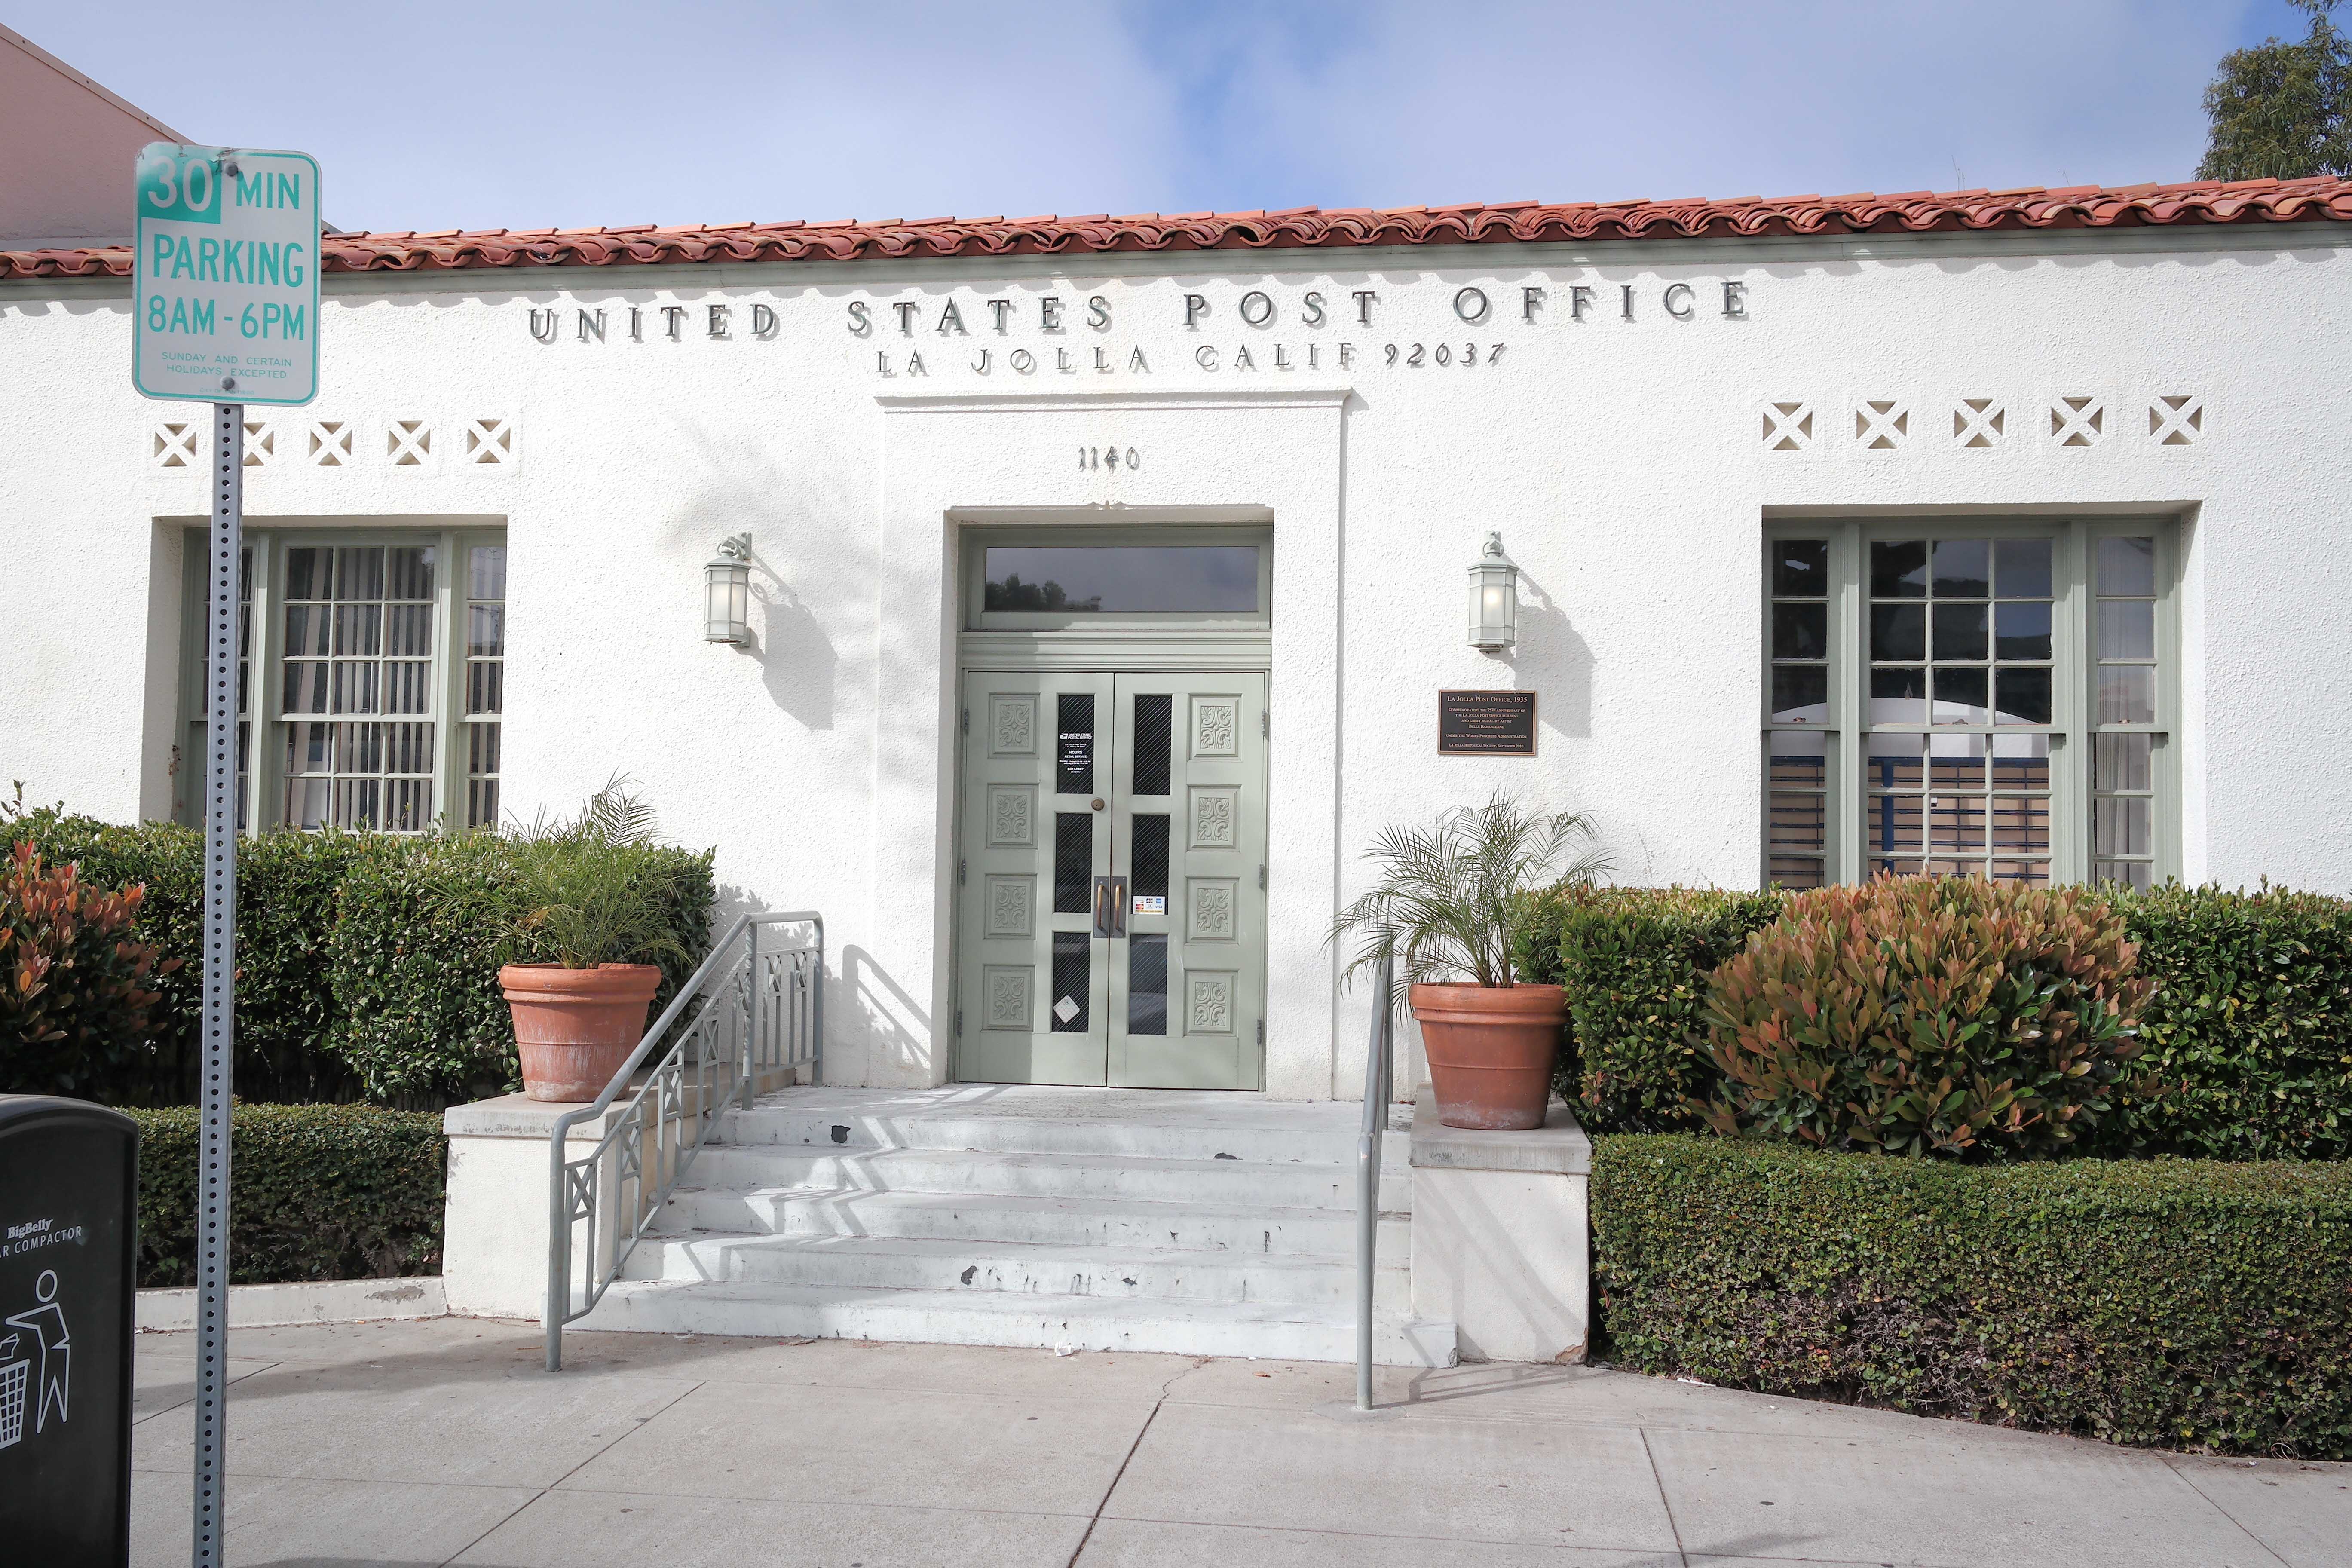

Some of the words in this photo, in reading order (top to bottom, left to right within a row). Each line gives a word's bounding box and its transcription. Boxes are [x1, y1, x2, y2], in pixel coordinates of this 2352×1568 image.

[148, 155, 213, 212] 30
[236, 171, 299, 210] MIN
[152, 233, 303, 288] PARKING
[527, 304, 774, 339] UNITED
[847, 296, 1107, 332] STATES
[1182, 291, 1375, 326] POST
[1453, 281, 1744, 321] OFFICE
[162, 351, 207, 361] SUNDAY
[215, 355, 238, 364] AND
[246, 357, 292, 367] CERTAIN
[876, 349, 925, 372] LA
[971, 344, 1146, 372] JOLLA
[1195, 343, 1352, 366] CALIF
[1384, 342, 1504, 365] 92037
[167, 364, 222, 375] HOLIDAYS
[231, 368, 287, 379] EXCEPTED
[1078, 446, 1140, 472] 1140
[7, 1218, 53, 1239] BigBelly
[15, 1226, 82, 1253] COMPACTOR
